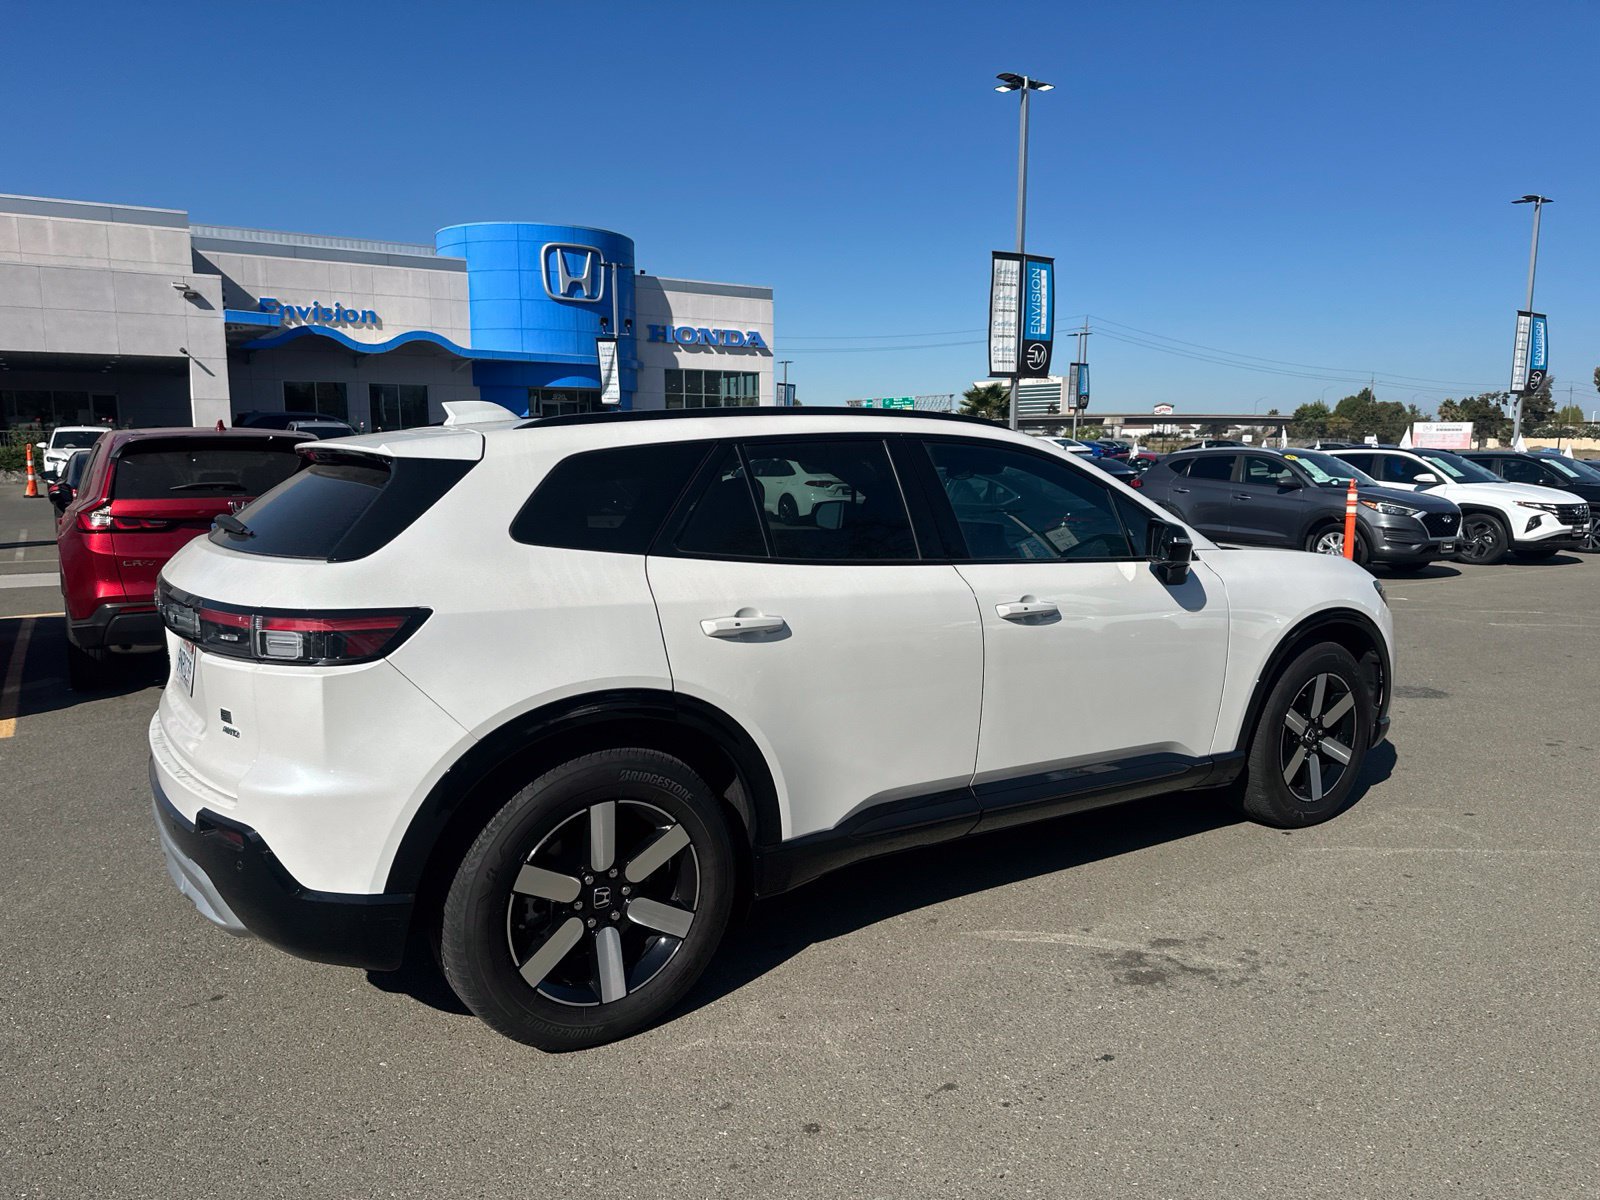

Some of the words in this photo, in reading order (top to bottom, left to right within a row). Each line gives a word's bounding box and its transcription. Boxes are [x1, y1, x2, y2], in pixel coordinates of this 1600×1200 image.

[259, 297, 377, 324] Envision
[1030, 268, 1041, 334] ENVISION
[646, 324, 768, 348] HONDA
[1534, 321, 1542, 366] ENVISION
[619, 769, 694, 801] BRIDGESTONE
